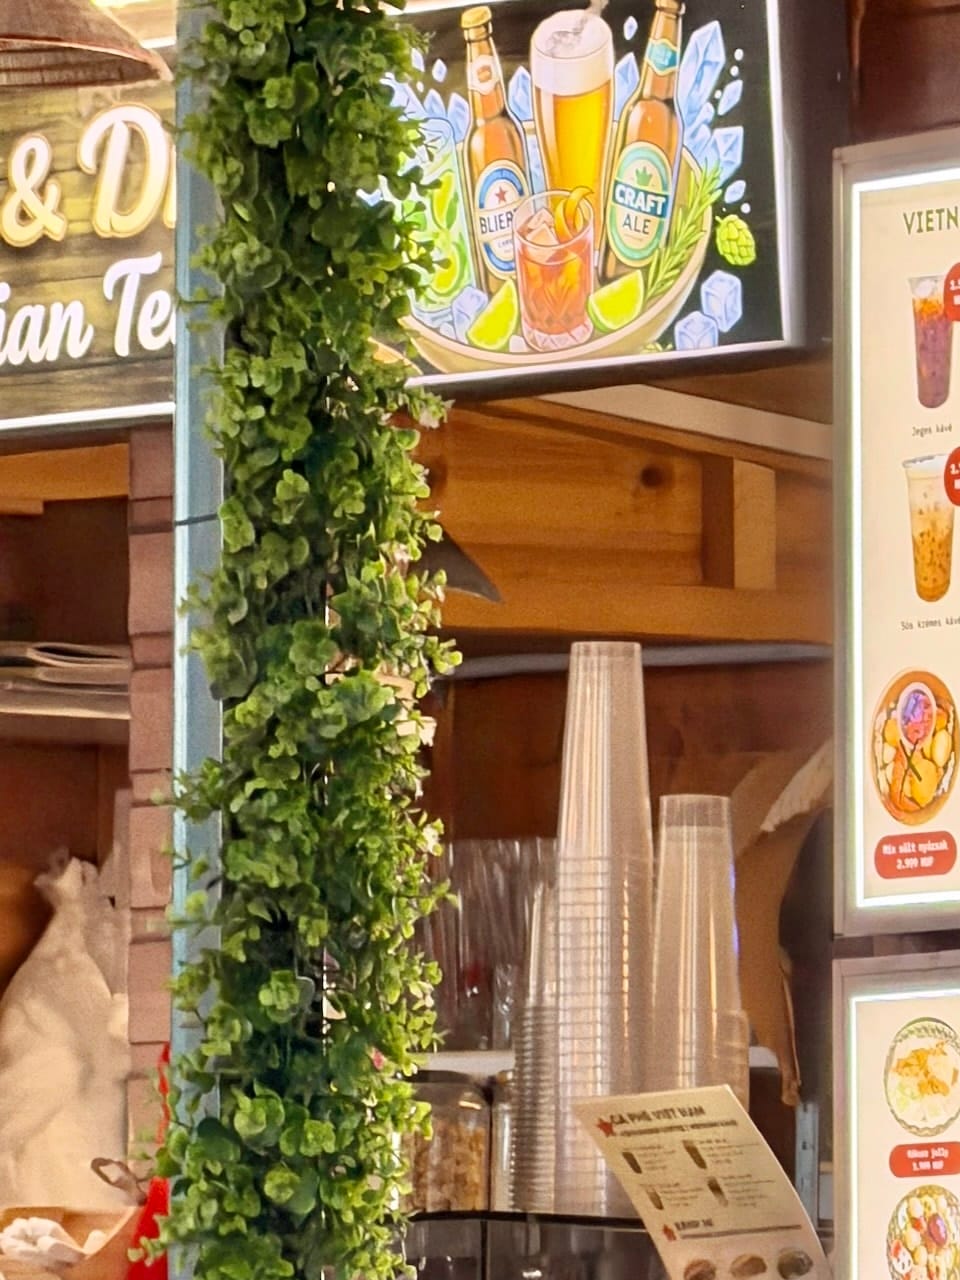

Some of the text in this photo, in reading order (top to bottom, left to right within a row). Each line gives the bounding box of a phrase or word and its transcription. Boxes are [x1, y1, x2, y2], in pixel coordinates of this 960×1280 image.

[1, 101, 176, 247] & D
[614, 182, 666, 216] CRAFT
[479, 208, 518, 234] BLIER
[623, 214, 651, 234] ALE
[912, 426, 932, 438] Jeges
